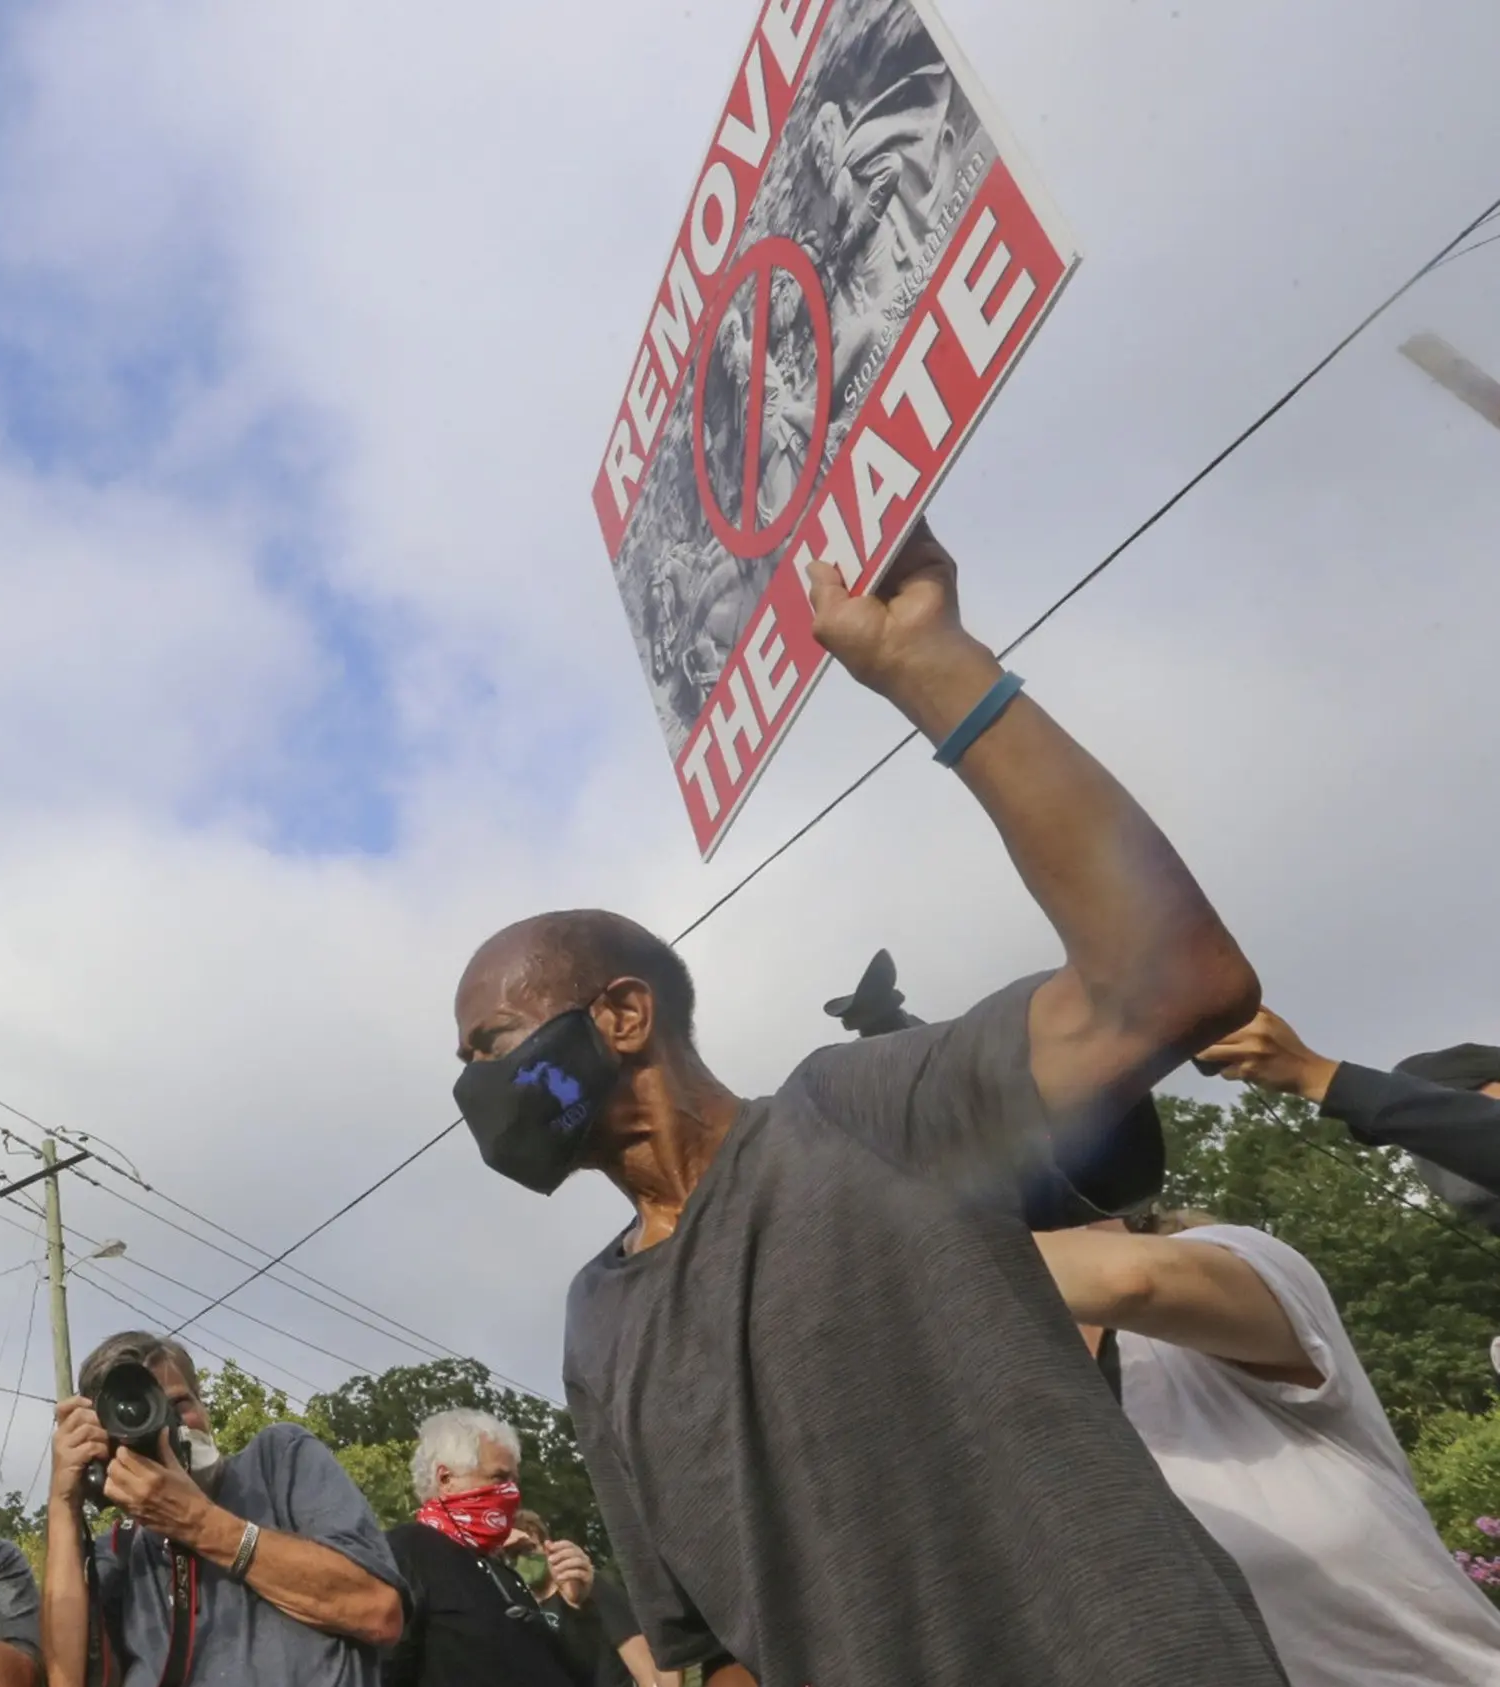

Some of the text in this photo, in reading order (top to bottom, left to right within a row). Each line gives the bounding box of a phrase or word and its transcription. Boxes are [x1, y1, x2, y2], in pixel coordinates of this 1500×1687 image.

[605, 0, 824, 521] REMOVE
[682, 205, 1037, 822] THE HATE
[843, 151, 987, 410] Stone Mountain
